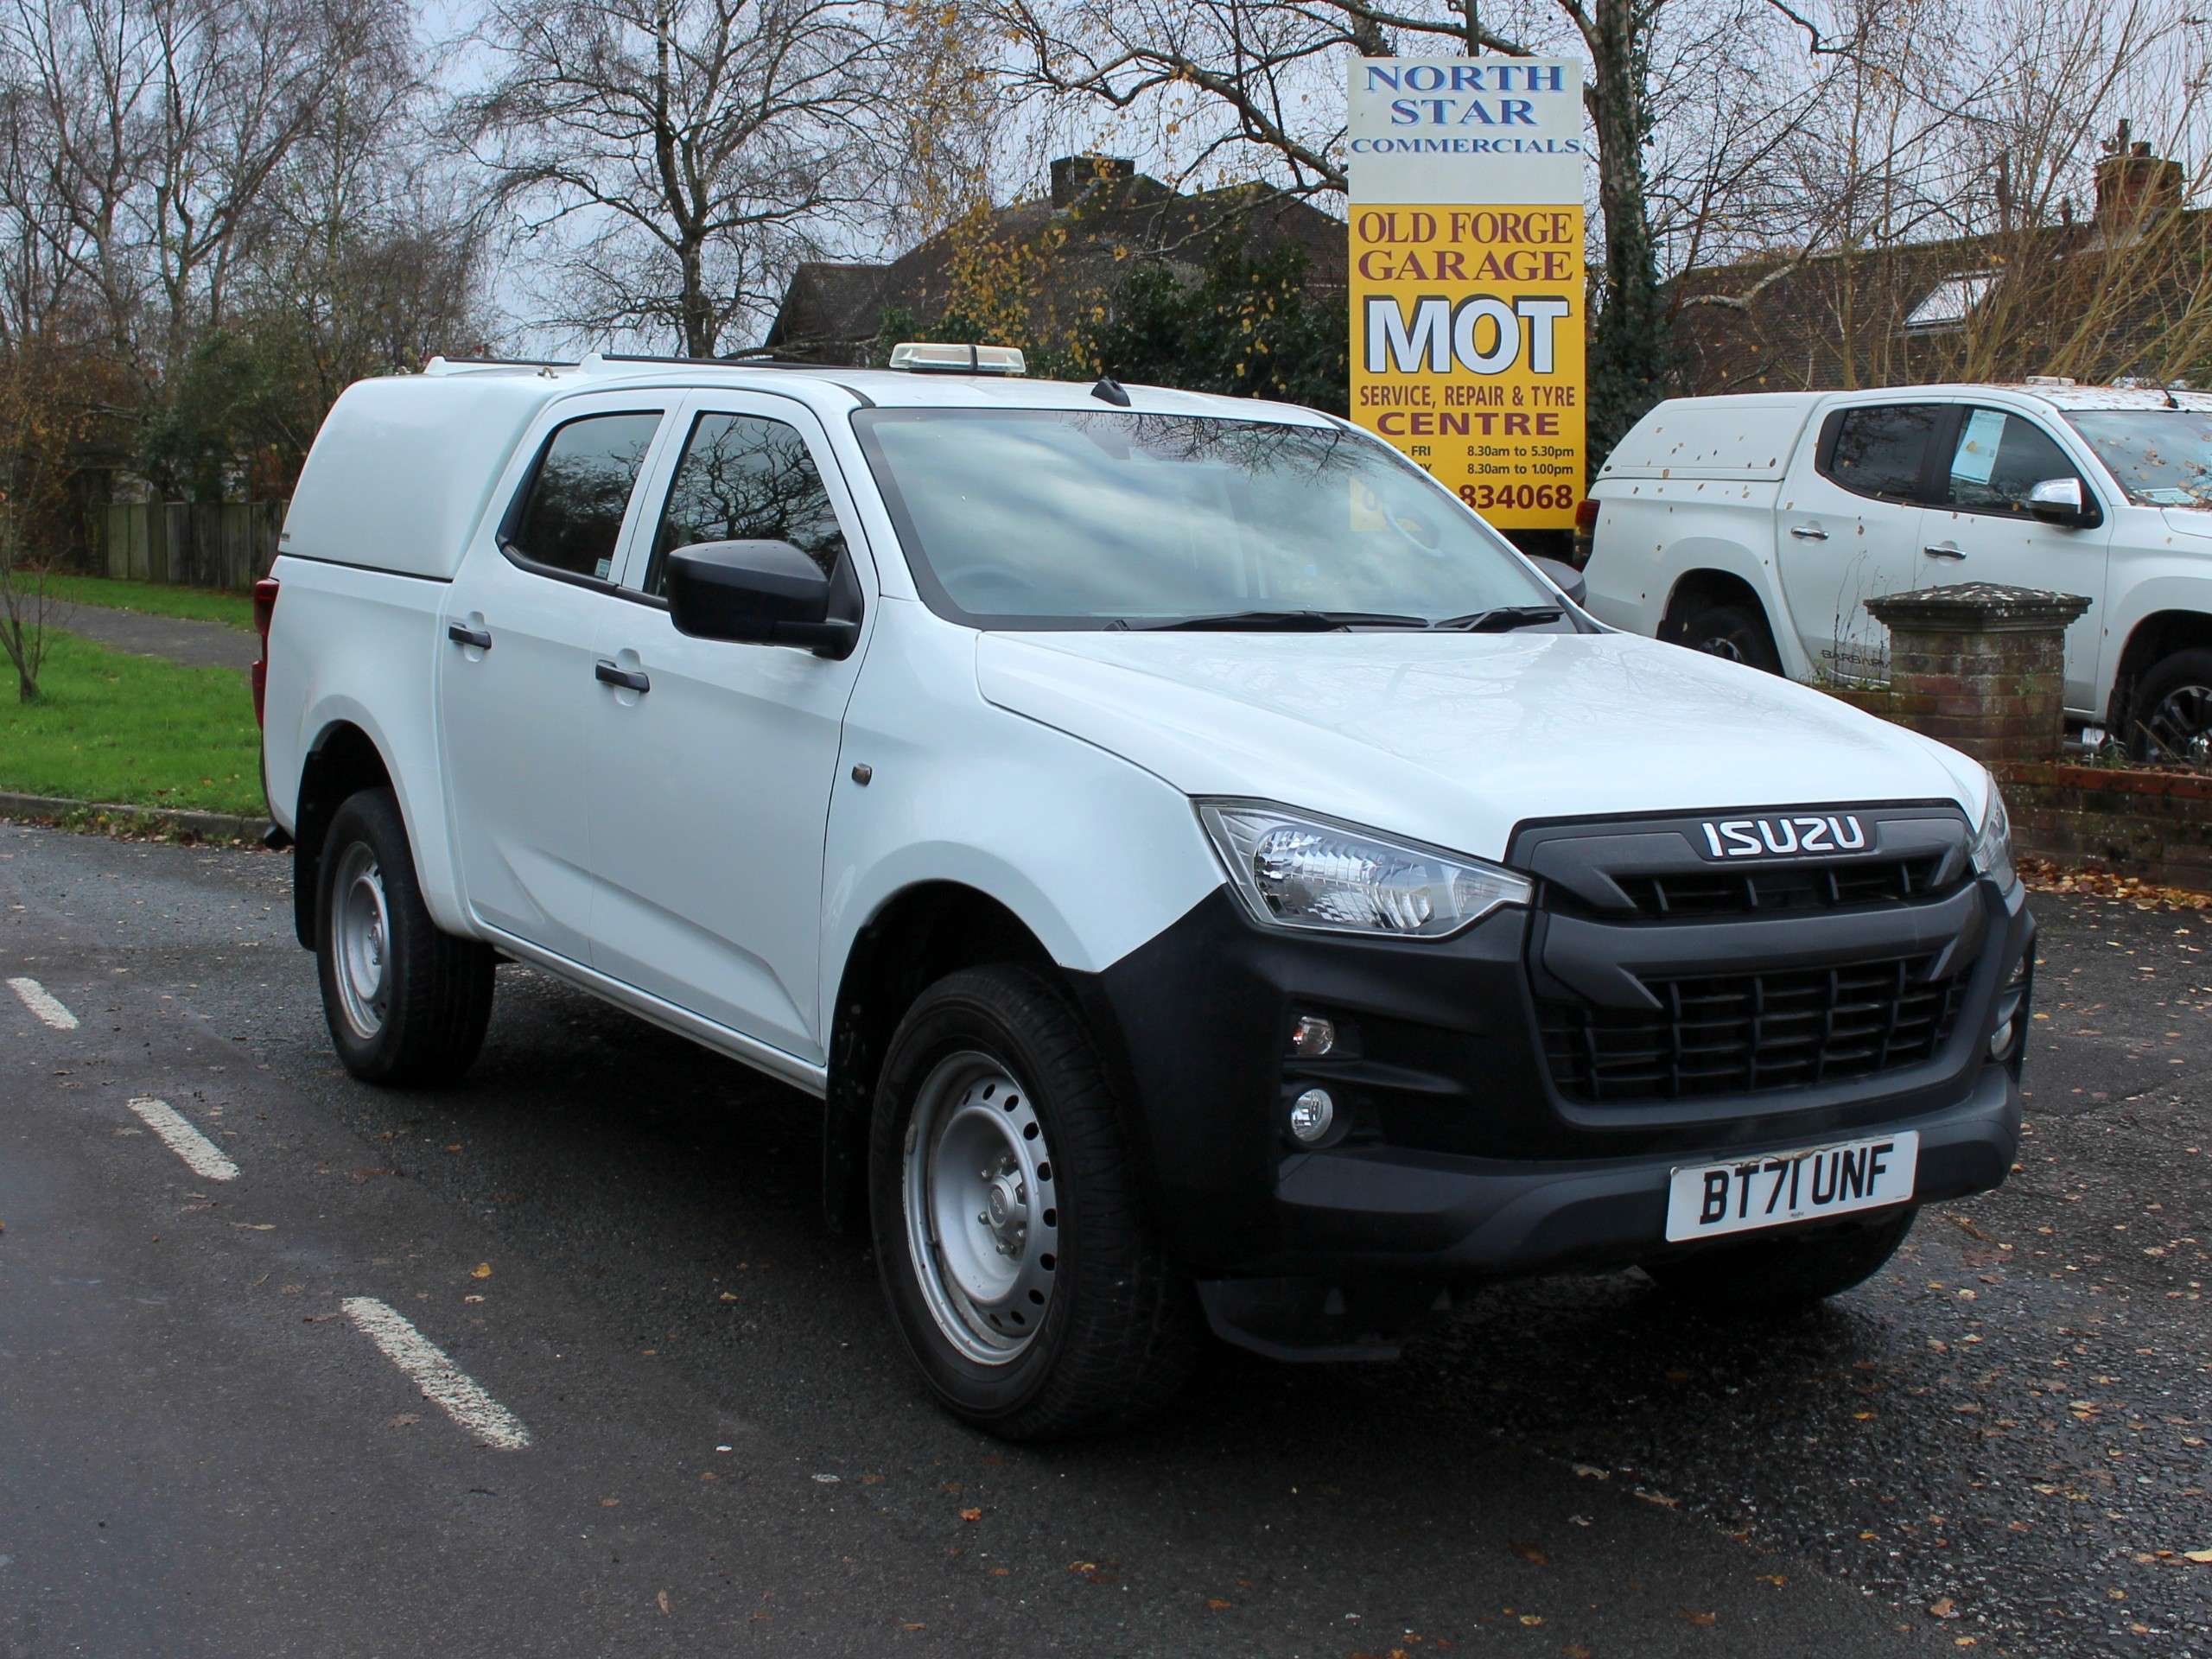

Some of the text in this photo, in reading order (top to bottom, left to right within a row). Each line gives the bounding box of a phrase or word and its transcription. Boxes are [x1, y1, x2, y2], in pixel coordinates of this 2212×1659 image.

[1364, 66, 1565, 92] NORTH
[1391, 99, 1537, 125] STAR
[1351, 138, 1580, 154] COMMERCIALS
[1358, 212, 1573, 244] OLD FORGE
[1358, 251, 1573, 281] GARAGE
[1363, 294, 1569, 374] MOT
[1360, 385, 1575, 409] SERVICE, REPAIR & TYRE
[1377, 412, 1560, 435] CENTRE
[1411, 445, 1574, 460] FRI 8.30am to 5.30pm
[1467, 463, 1574, 477] 8.30am to 1.00pm
[1459, 484, 1573, 509] 834068
[1701, 816, 1866, 857] ISUZU
[1699, 1142, 1894, 1225] BT71 UNF
